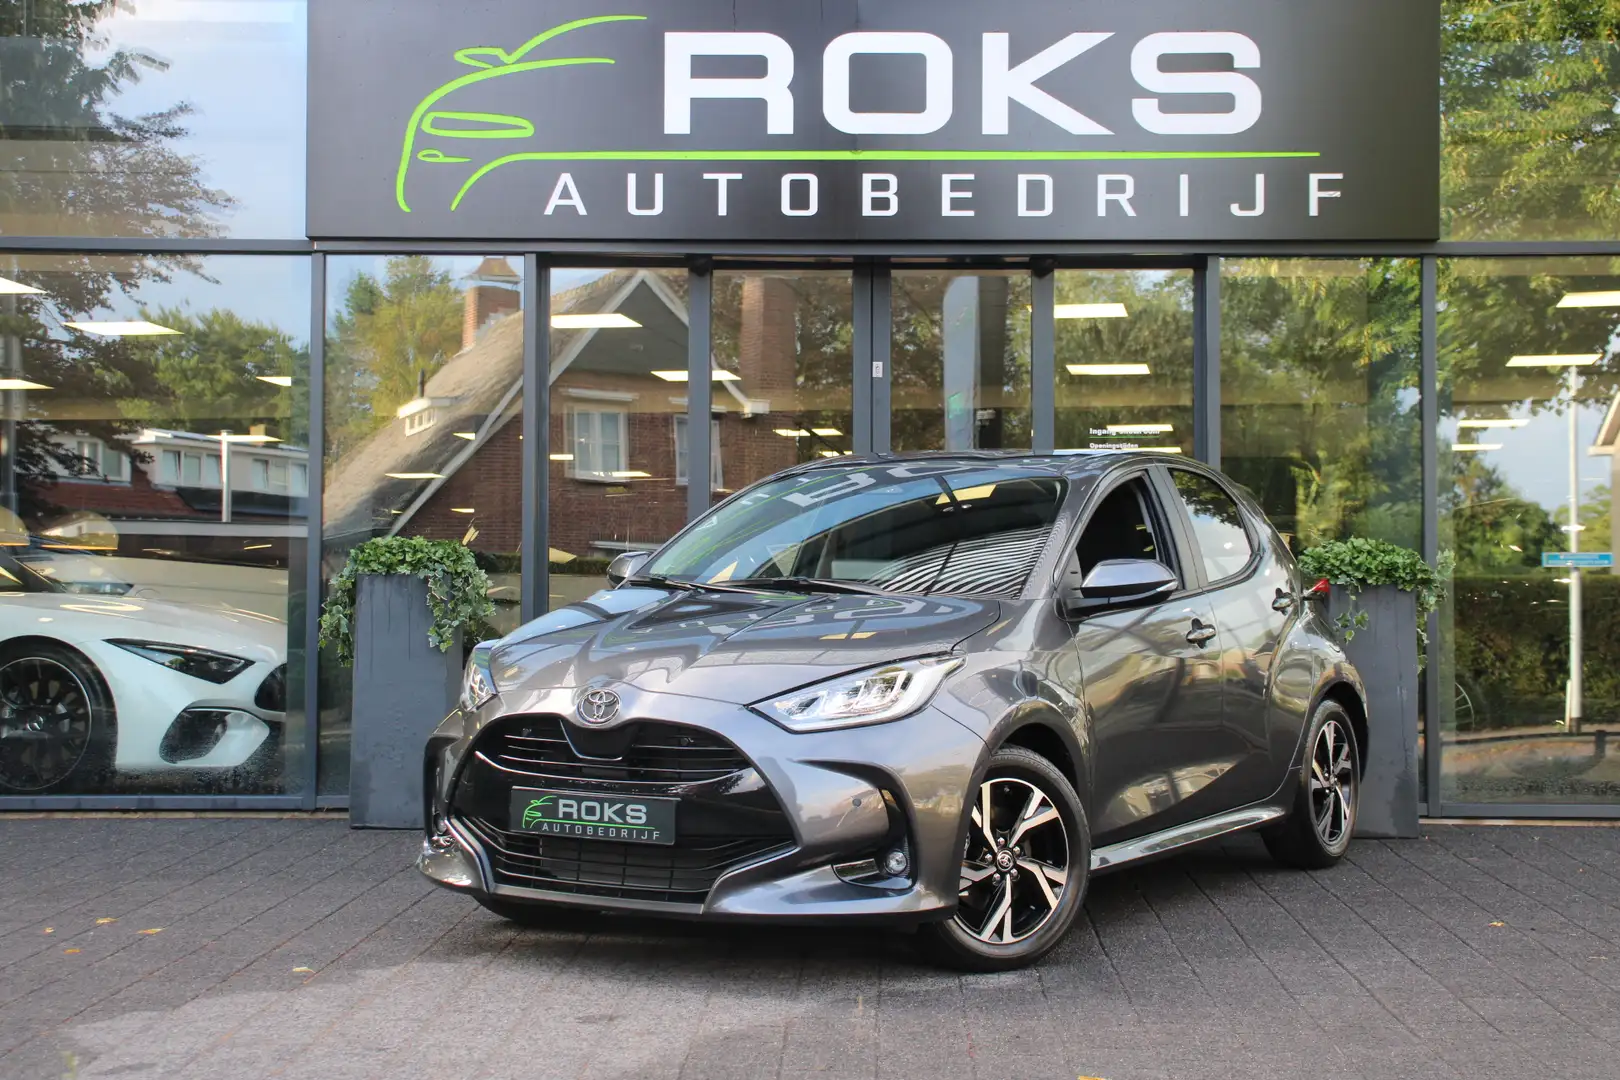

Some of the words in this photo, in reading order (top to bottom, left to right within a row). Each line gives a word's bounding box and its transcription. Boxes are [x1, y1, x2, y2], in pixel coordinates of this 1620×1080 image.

[663, 31, 1263, 136] ROKS
[543, 172, 1344, 218] AUTOBEDRIJF
[558, 798, 647, 825] ROKS
[541, 822, 661, 841] AUTOBEDRIJF
